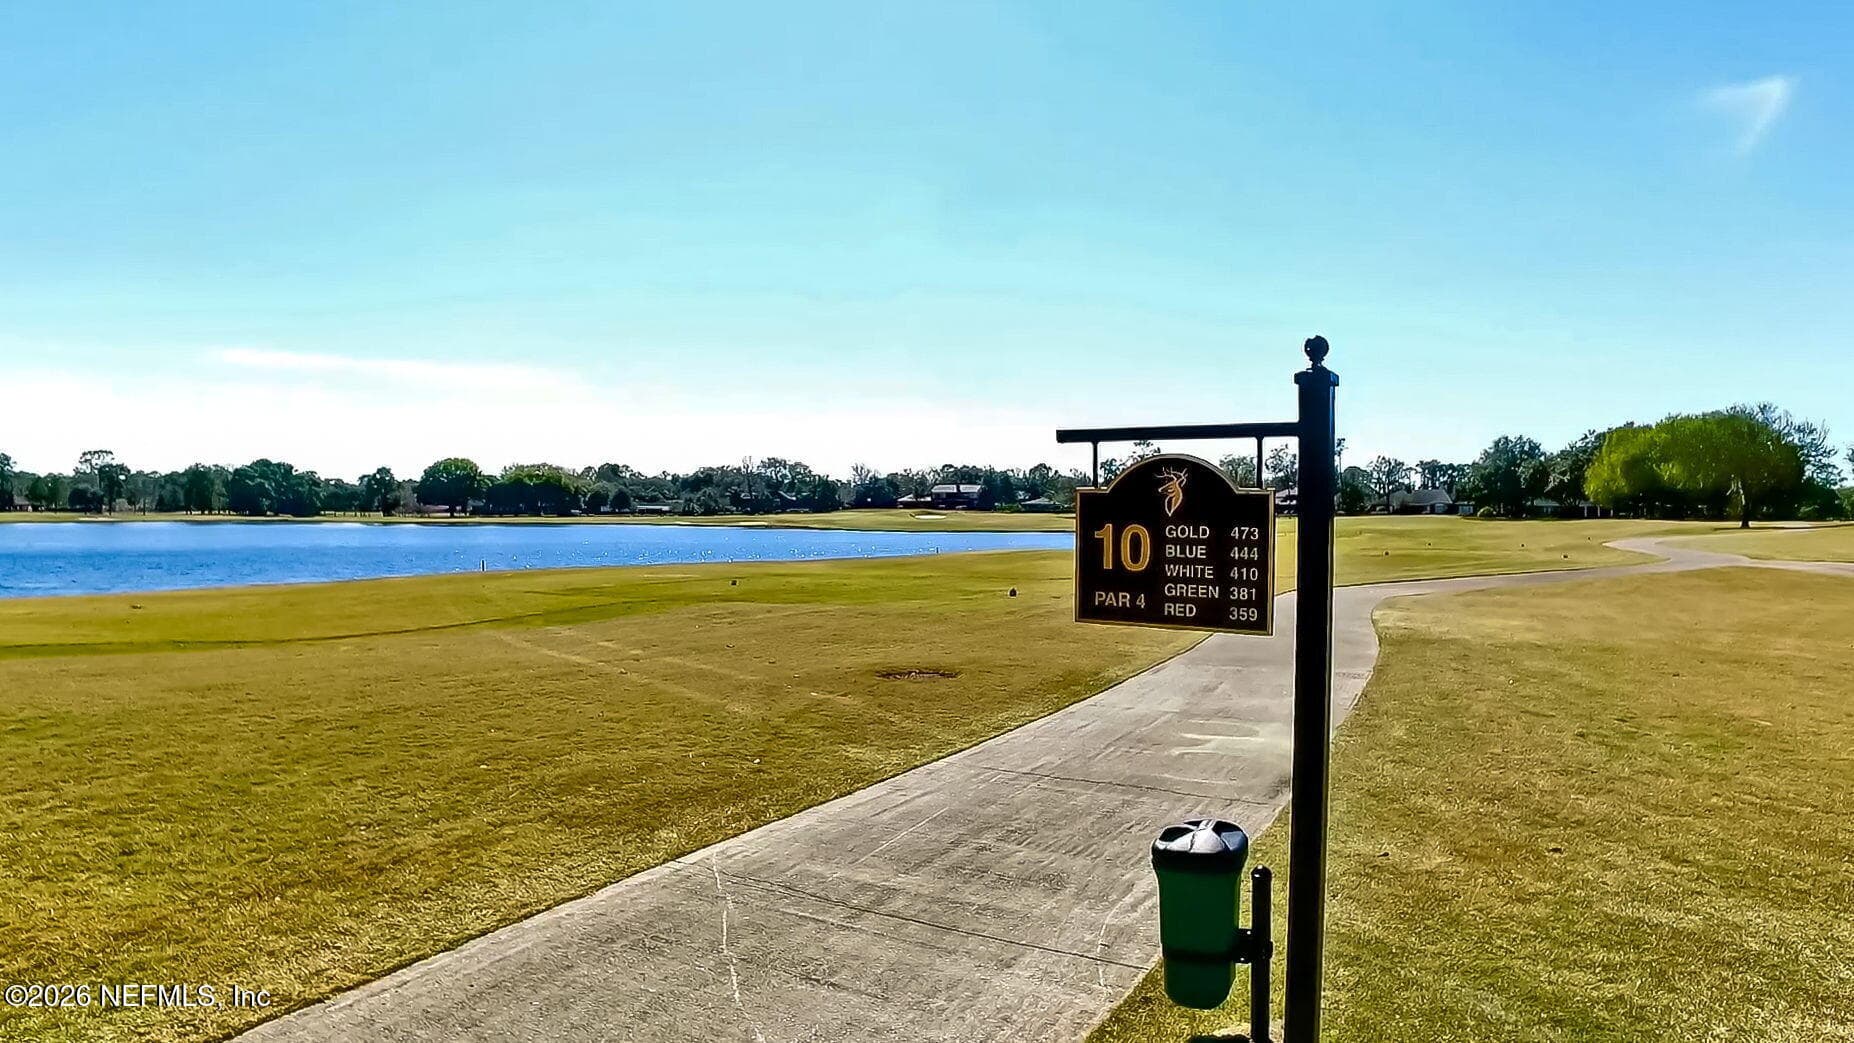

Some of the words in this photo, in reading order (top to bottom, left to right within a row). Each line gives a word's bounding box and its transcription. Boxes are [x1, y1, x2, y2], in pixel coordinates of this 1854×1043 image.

[1165, 525, 1210, 539] GOLD
[1230, 527, 1259, 540] 473
[1094, 523, 1151, 572] 10
[1165, 545, 1207, 558] BLUE
[1230, 547, 1259, 560] 444
[1165, 565, 1214, 579] WHITE
[1230, 568, 1258, 581] 410
[1095, 591, 1130, 608] PAR
[1136, 594, 1146, 609] 4
[1164, 585, 1219, 599] GREEN
[1229, 587, 1256, 601] 381
[1164, 603, 1197, 617] RED
[1229, 608, 1258, 621] 359
